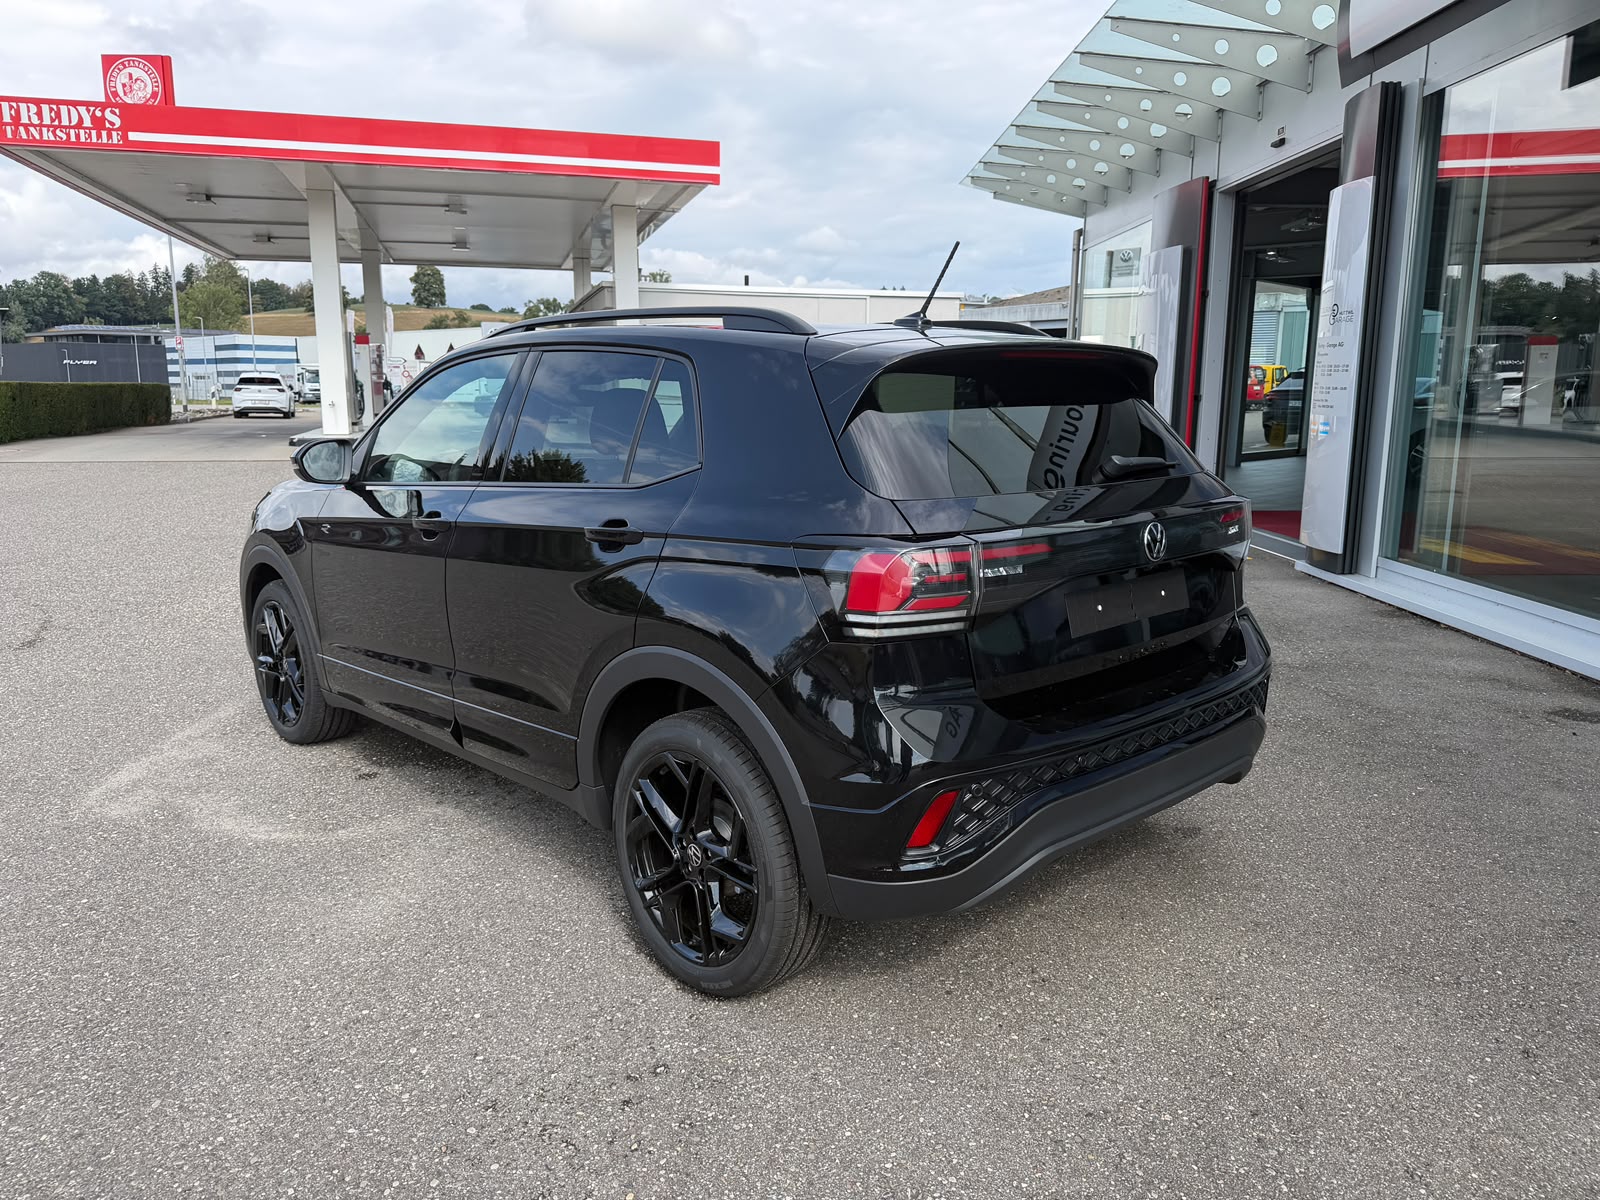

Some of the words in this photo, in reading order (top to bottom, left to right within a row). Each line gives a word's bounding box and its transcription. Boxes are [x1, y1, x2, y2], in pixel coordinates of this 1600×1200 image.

[123, 60, 160, 92] TANKSTELLE
[0, 101, 122, 129] FREDY'S
[2, 126, 123, 144] TANKSTELLE
